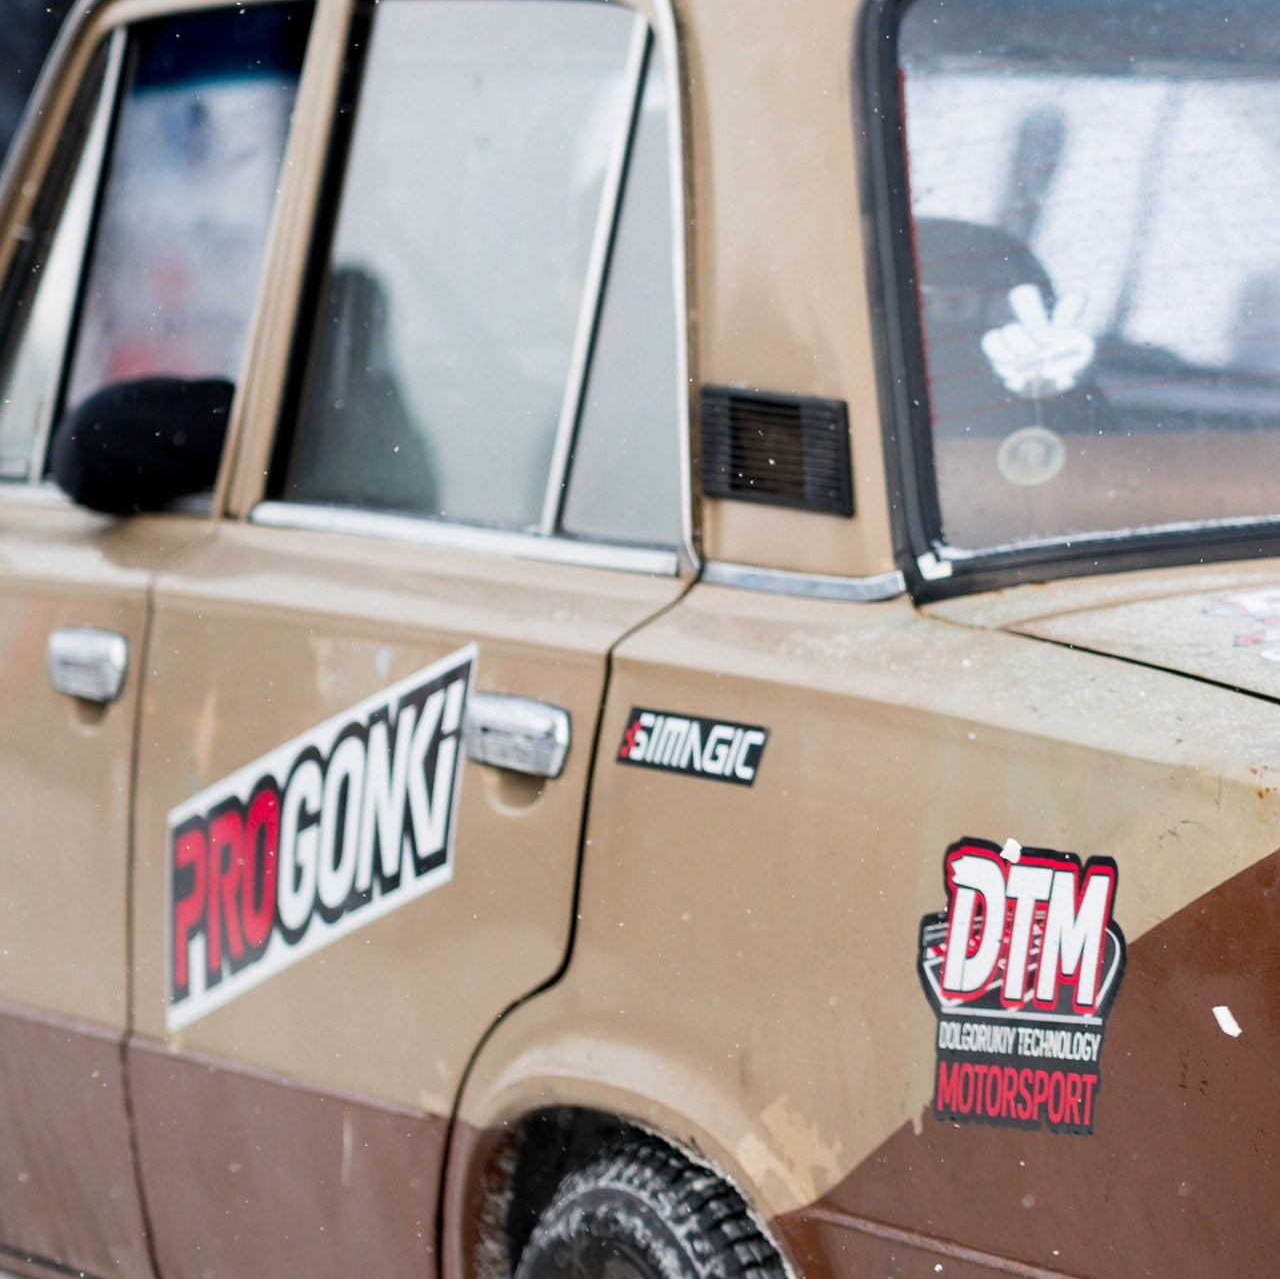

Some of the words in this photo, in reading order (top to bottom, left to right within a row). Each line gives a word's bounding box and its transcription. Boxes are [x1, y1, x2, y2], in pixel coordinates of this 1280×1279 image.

[628, 712, 766, 781] SIMAGIC
[172, 678, 466, 989] PROGONKI
[942, 854, 1111, 1007] DTM
[938, 1021, 1017, 1056] DOLGORUKIY
[1017, 1027, 1102, 1062] TECHNOLOGY
[936, 1060, 1098, 1126] MOTORSPORT
